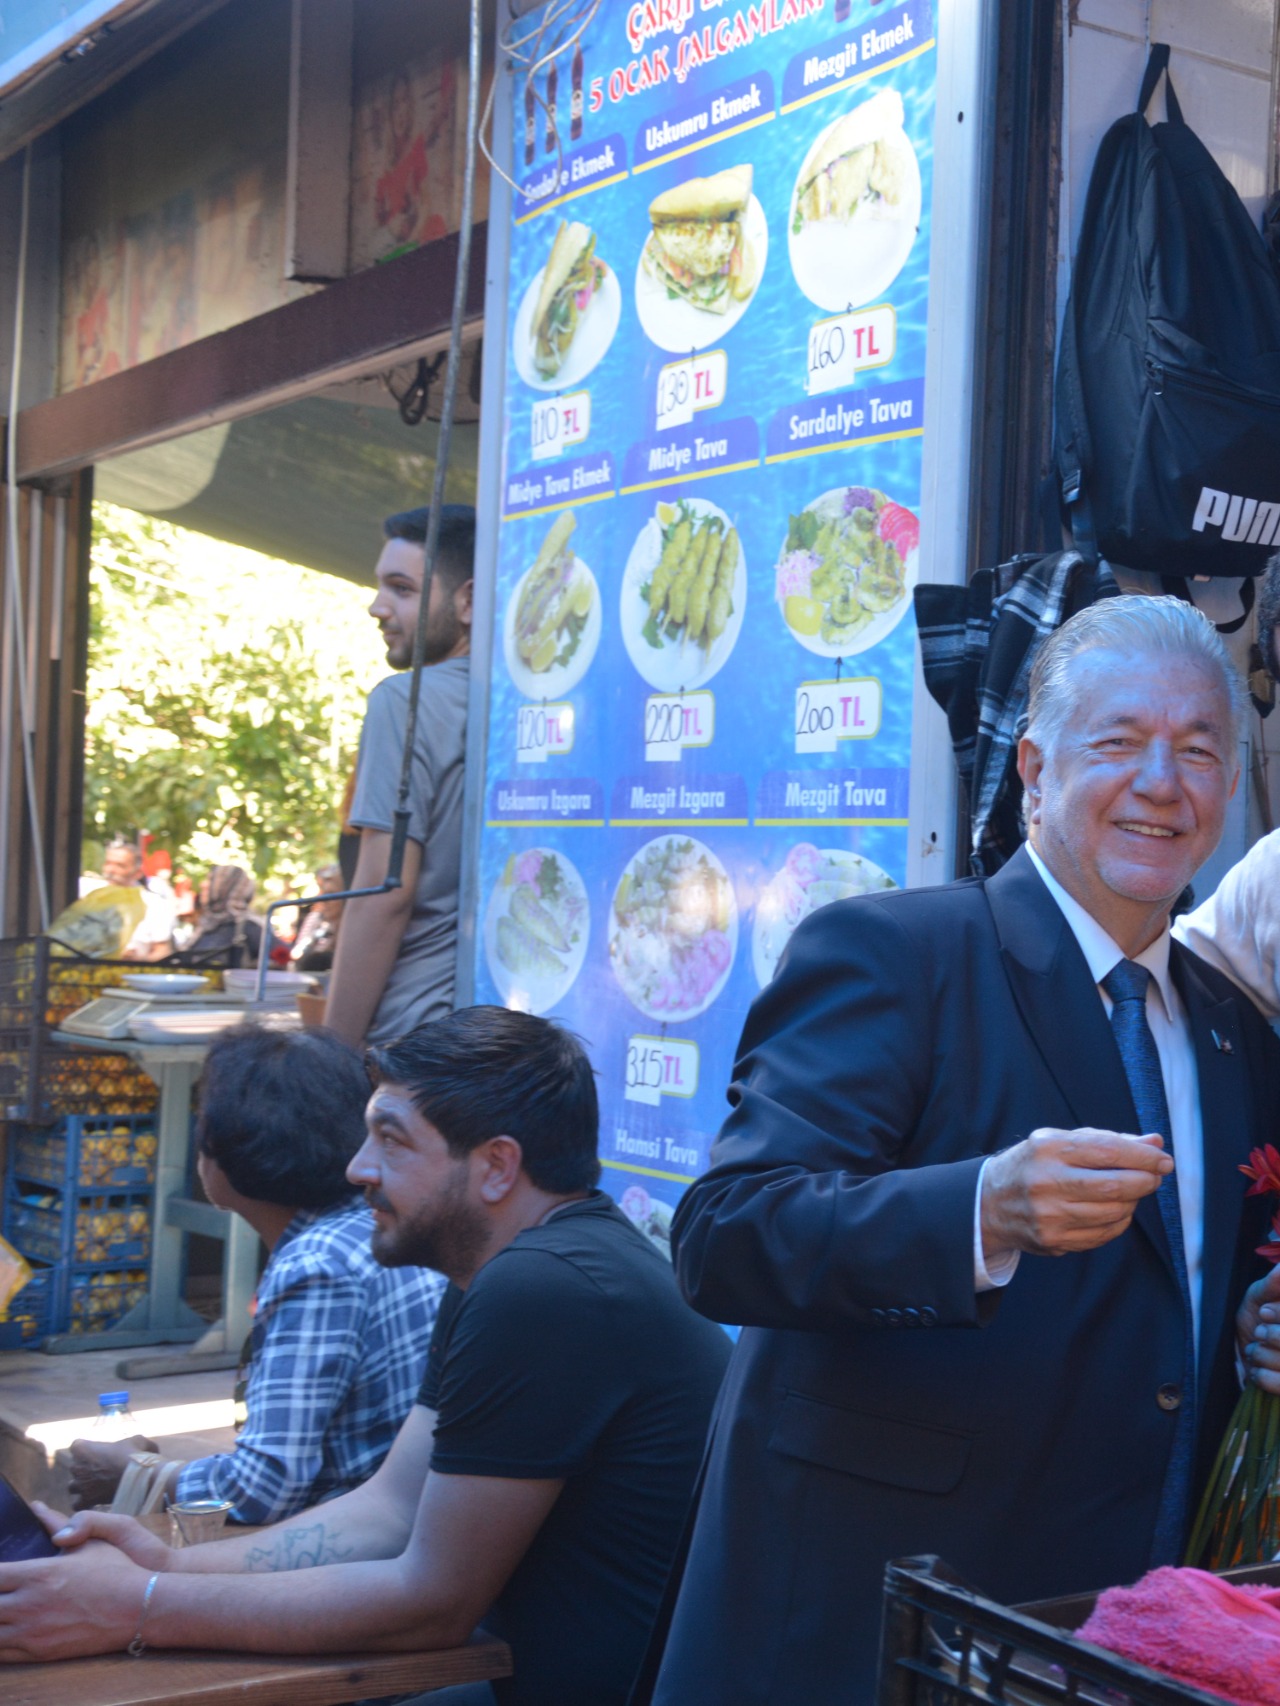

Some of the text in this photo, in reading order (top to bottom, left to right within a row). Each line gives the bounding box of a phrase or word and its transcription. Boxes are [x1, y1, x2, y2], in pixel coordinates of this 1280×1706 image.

[589, 0, 825, 111] 5 OCAK ŞALGAMLAR
[804, 14, 914, 85] Mezgit Ekmek
[646, 83, 760, 150] Uskumru Ekmek
[571, 145, 615, 181] Ekmek
[809, 325, 879, 372] 160 TL
[694, 370, 714, 400] TL
[563, 408, 580, 435] TL
[789, 397, 912, 441] Sardalye Tava
[648, 437, 728, 472] Midye Tava
[508, 460, 611, 505] Midye Tava Ekmek
[547, 718, 564, 743] TL
[646, 703, 702, 744] 220 TL
[796, 692, 865, 735] 200 TL
[498, 788, 591, 816] Uskumru Izgara
[630, 785, 725, 815] Mezgit Izgara
[785, 780, 886, 815] Mezgit Tava
[663, 1055, 684, 1085] TL
[615, 1129, 698, 1166] Hamsi Tava
